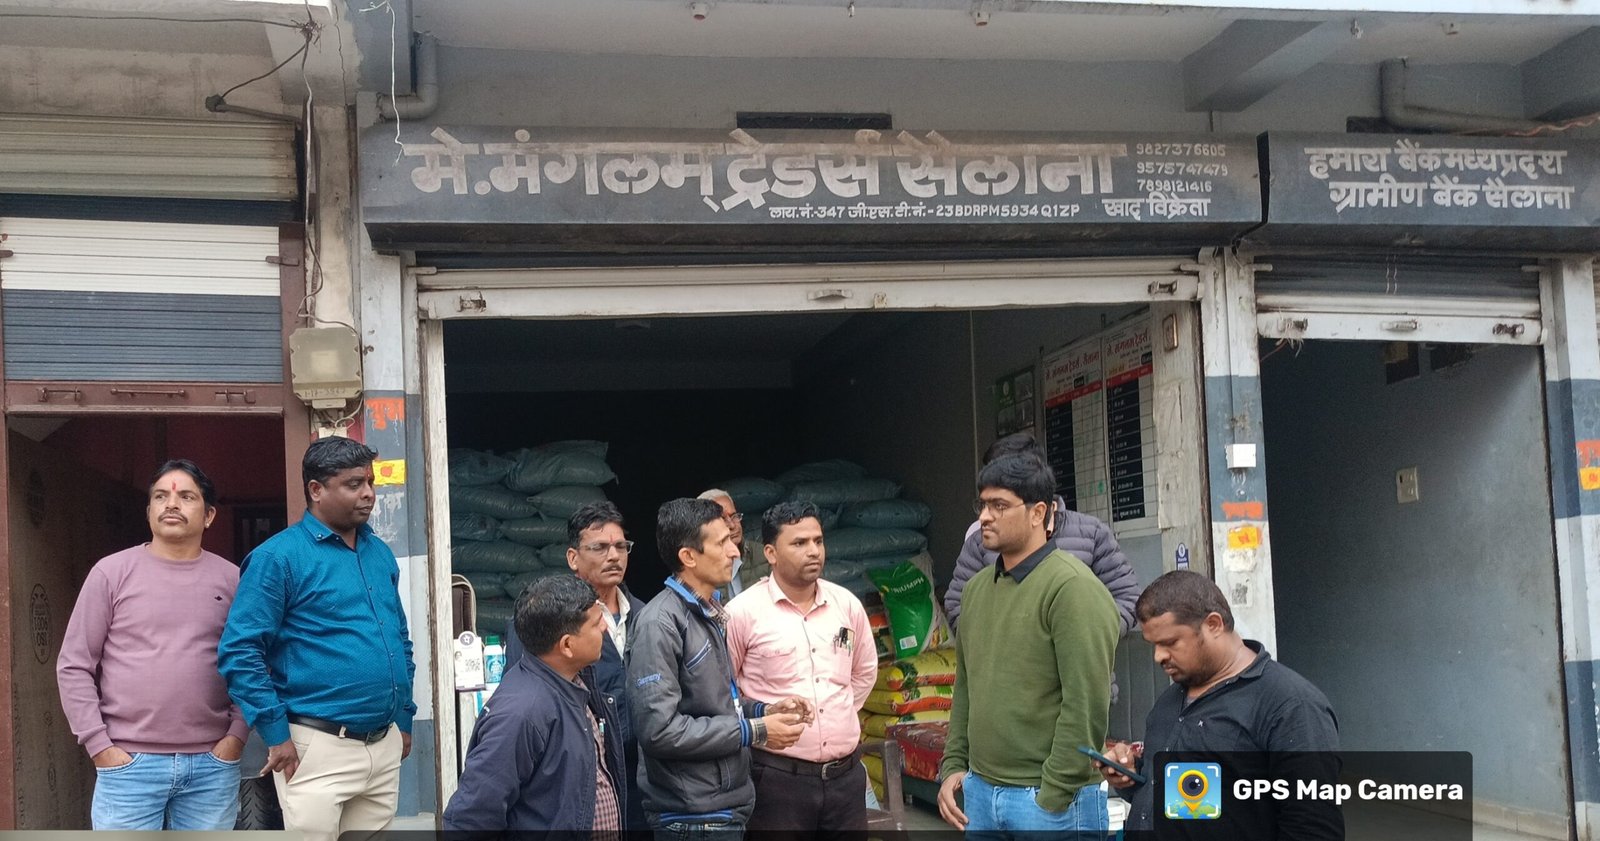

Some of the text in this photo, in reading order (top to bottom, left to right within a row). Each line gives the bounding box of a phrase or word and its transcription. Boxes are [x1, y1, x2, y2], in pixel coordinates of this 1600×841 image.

[1136, 143, 1226, 157] 9827376605
[1137, 162, 1228, 177] 9575747479
[1304, 148, 1391, 179] हमारा
[1137, 179, 1212, 193] 7898121416
[1329, 173, 1575, 213] ग्रामीण बैंक सैलाना
[1146, 191, 1211, 219] विक्रेता
